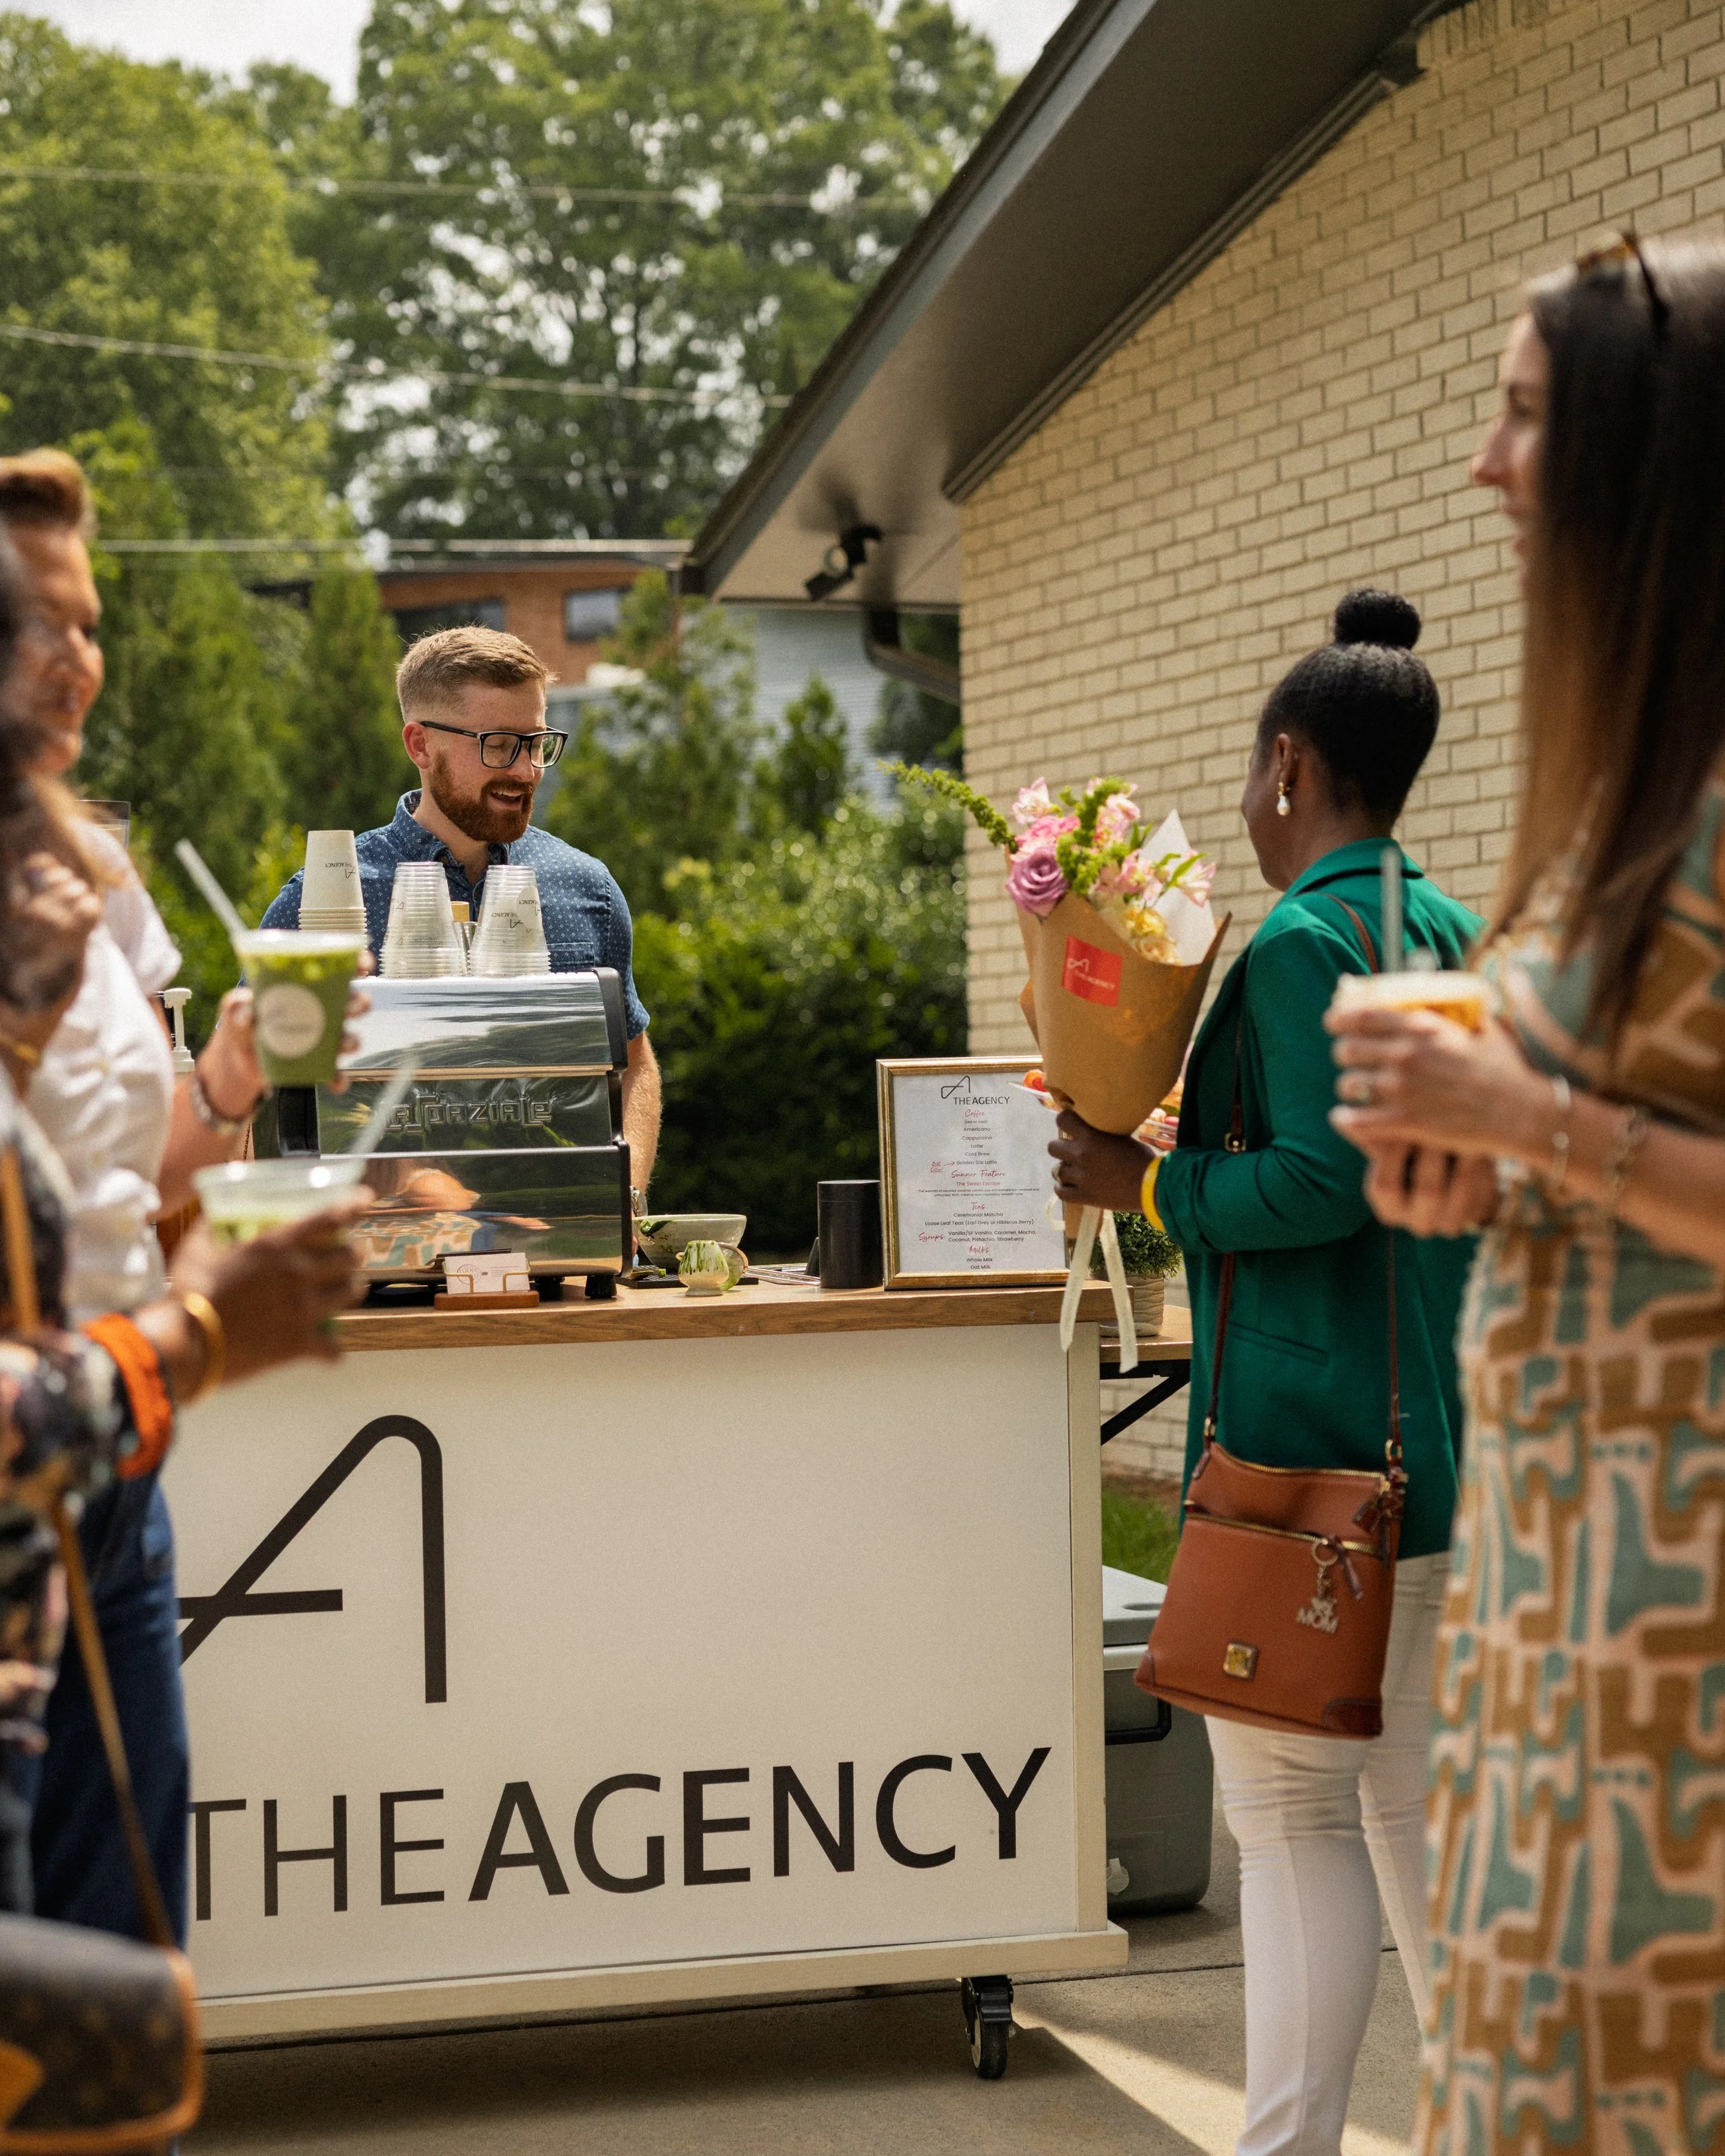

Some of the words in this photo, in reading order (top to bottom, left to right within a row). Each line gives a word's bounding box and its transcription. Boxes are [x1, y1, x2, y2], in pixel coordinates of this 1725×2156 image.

[965, 1109, 986, 1118] Coffee
[980, 1169, 1006, 1178] Feature
[971, 1202, 985, 1210] Teas
[969, 1245, 989, 1254] Milks
